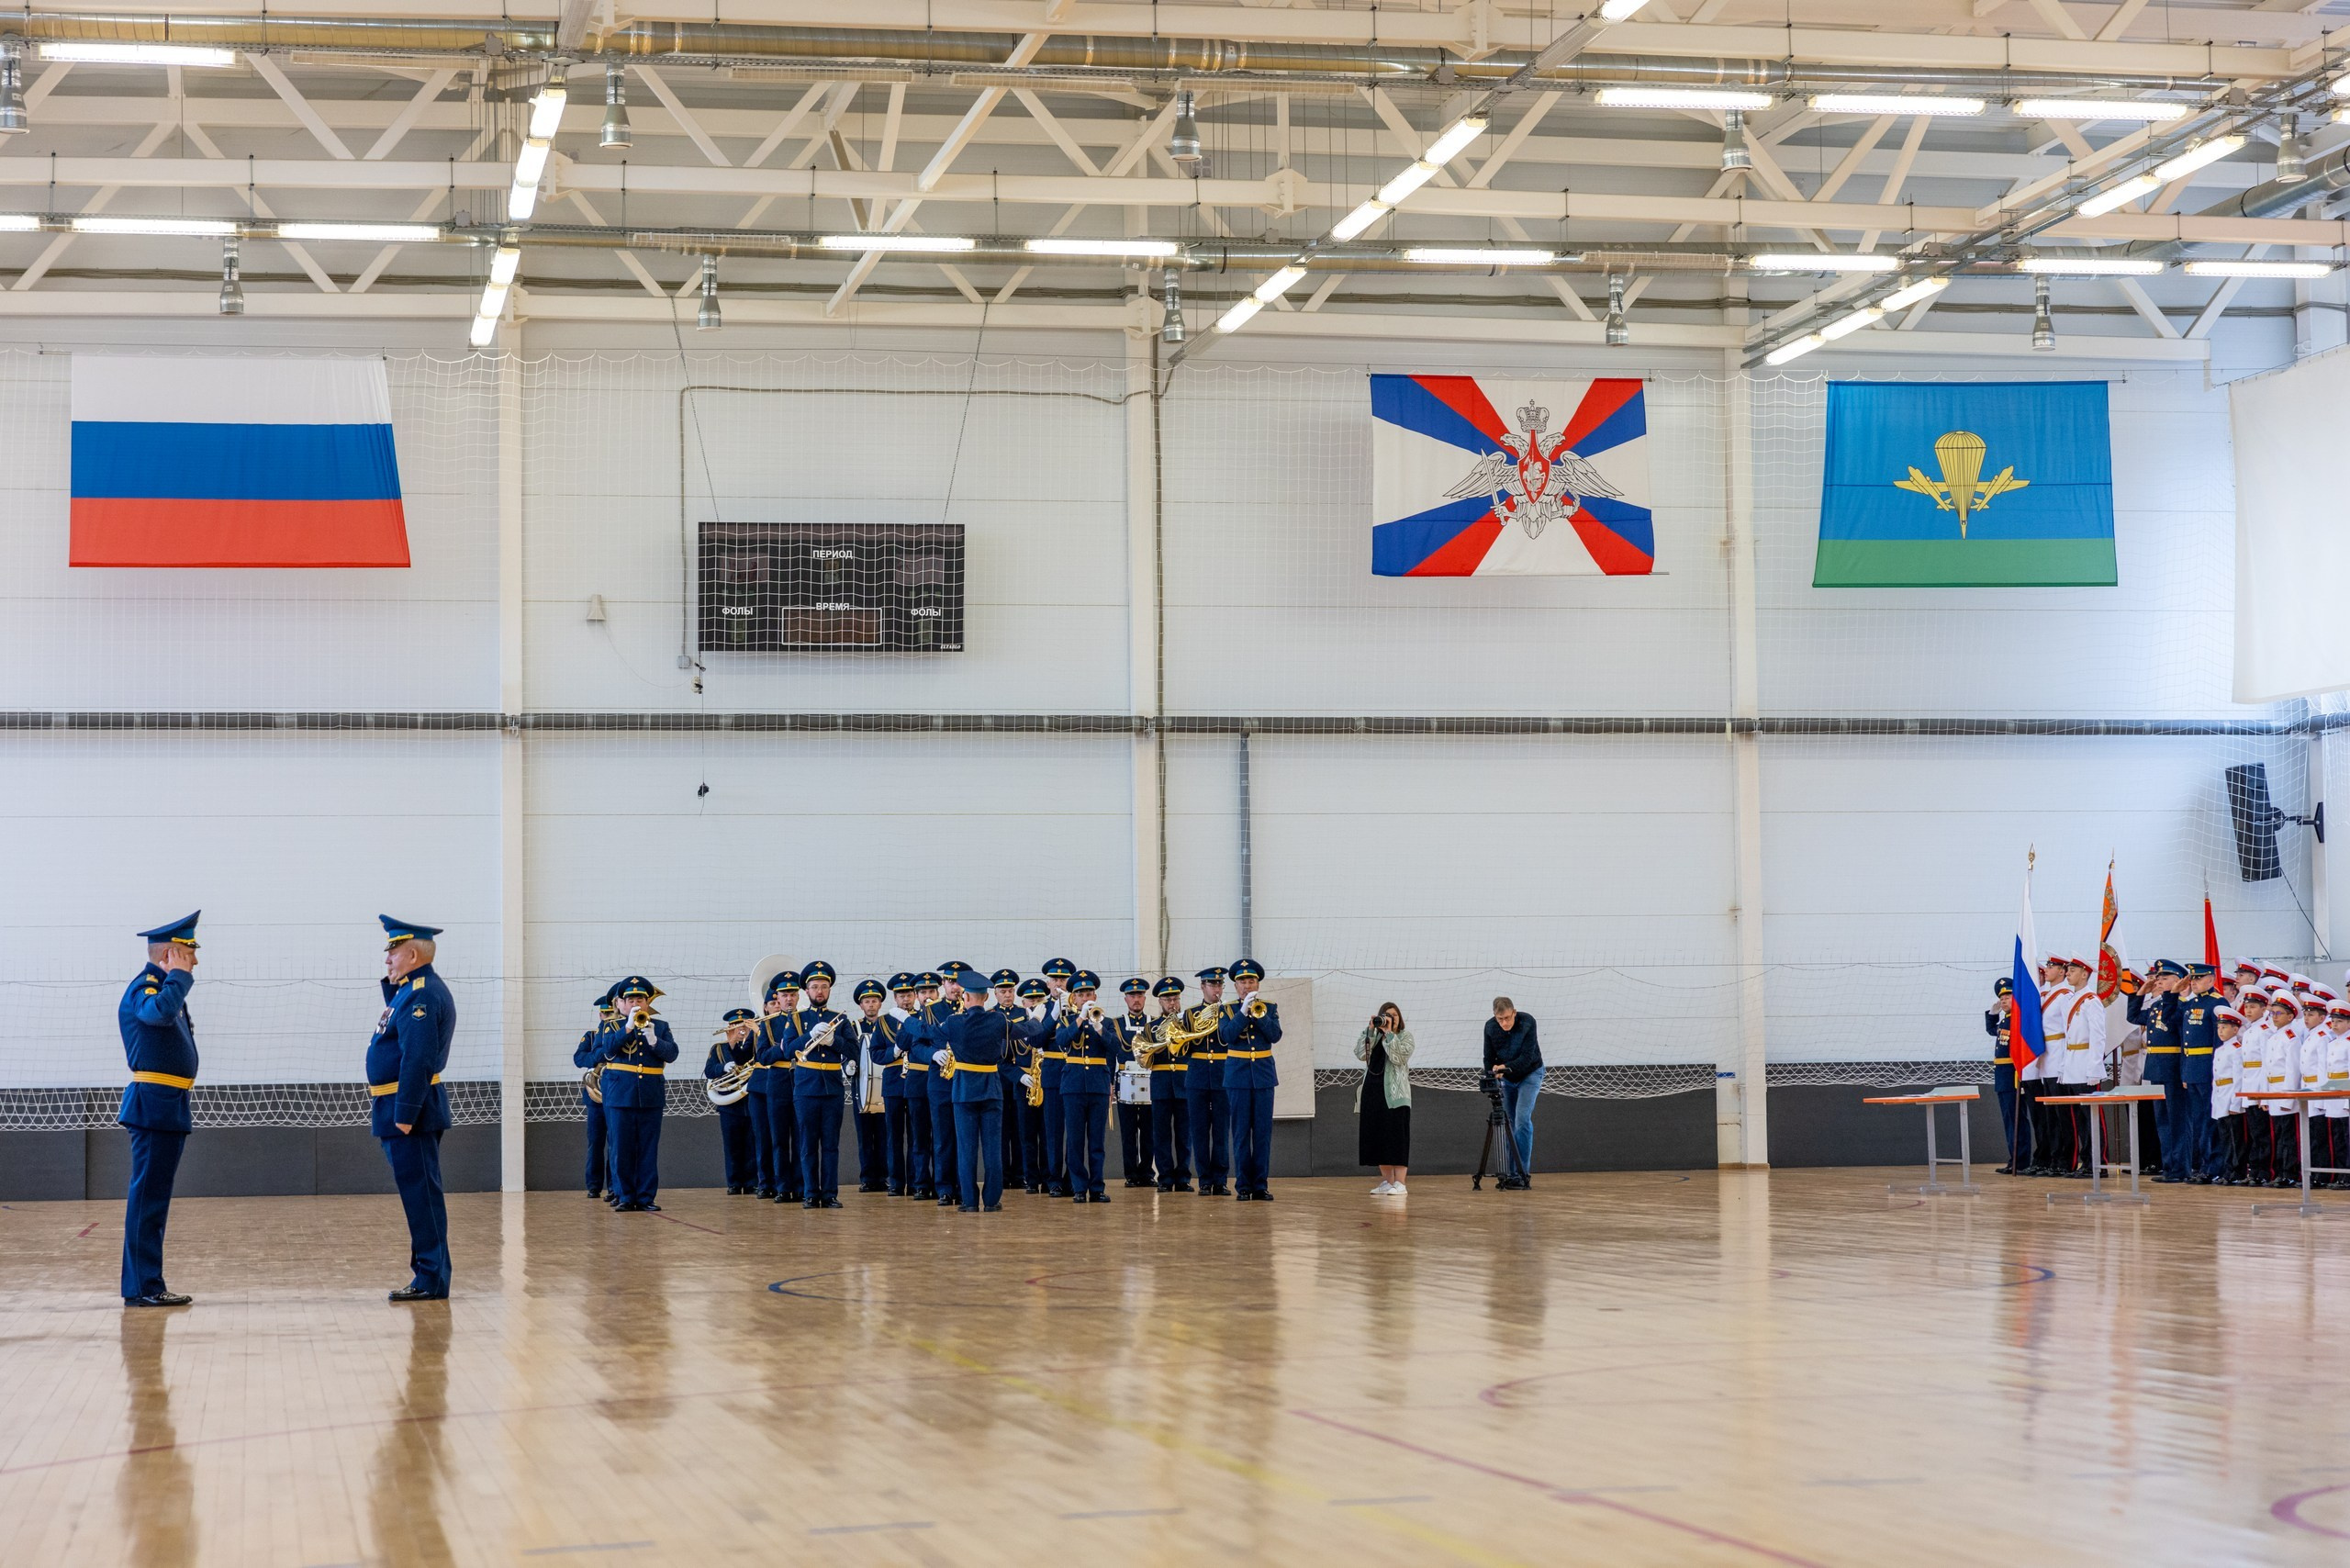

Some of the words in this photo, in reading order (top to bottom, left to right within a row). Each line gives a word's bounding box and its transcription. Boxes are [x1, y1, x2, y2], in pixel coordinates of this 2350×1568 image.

[812, 550, 853, 559] ПЕРИОД
[815, 602, 850, 610] ВРЕМЯ
[722, 607, 753, 615] ФОЛЫ
[911, 608, 941, 616] ФОЛЫ
